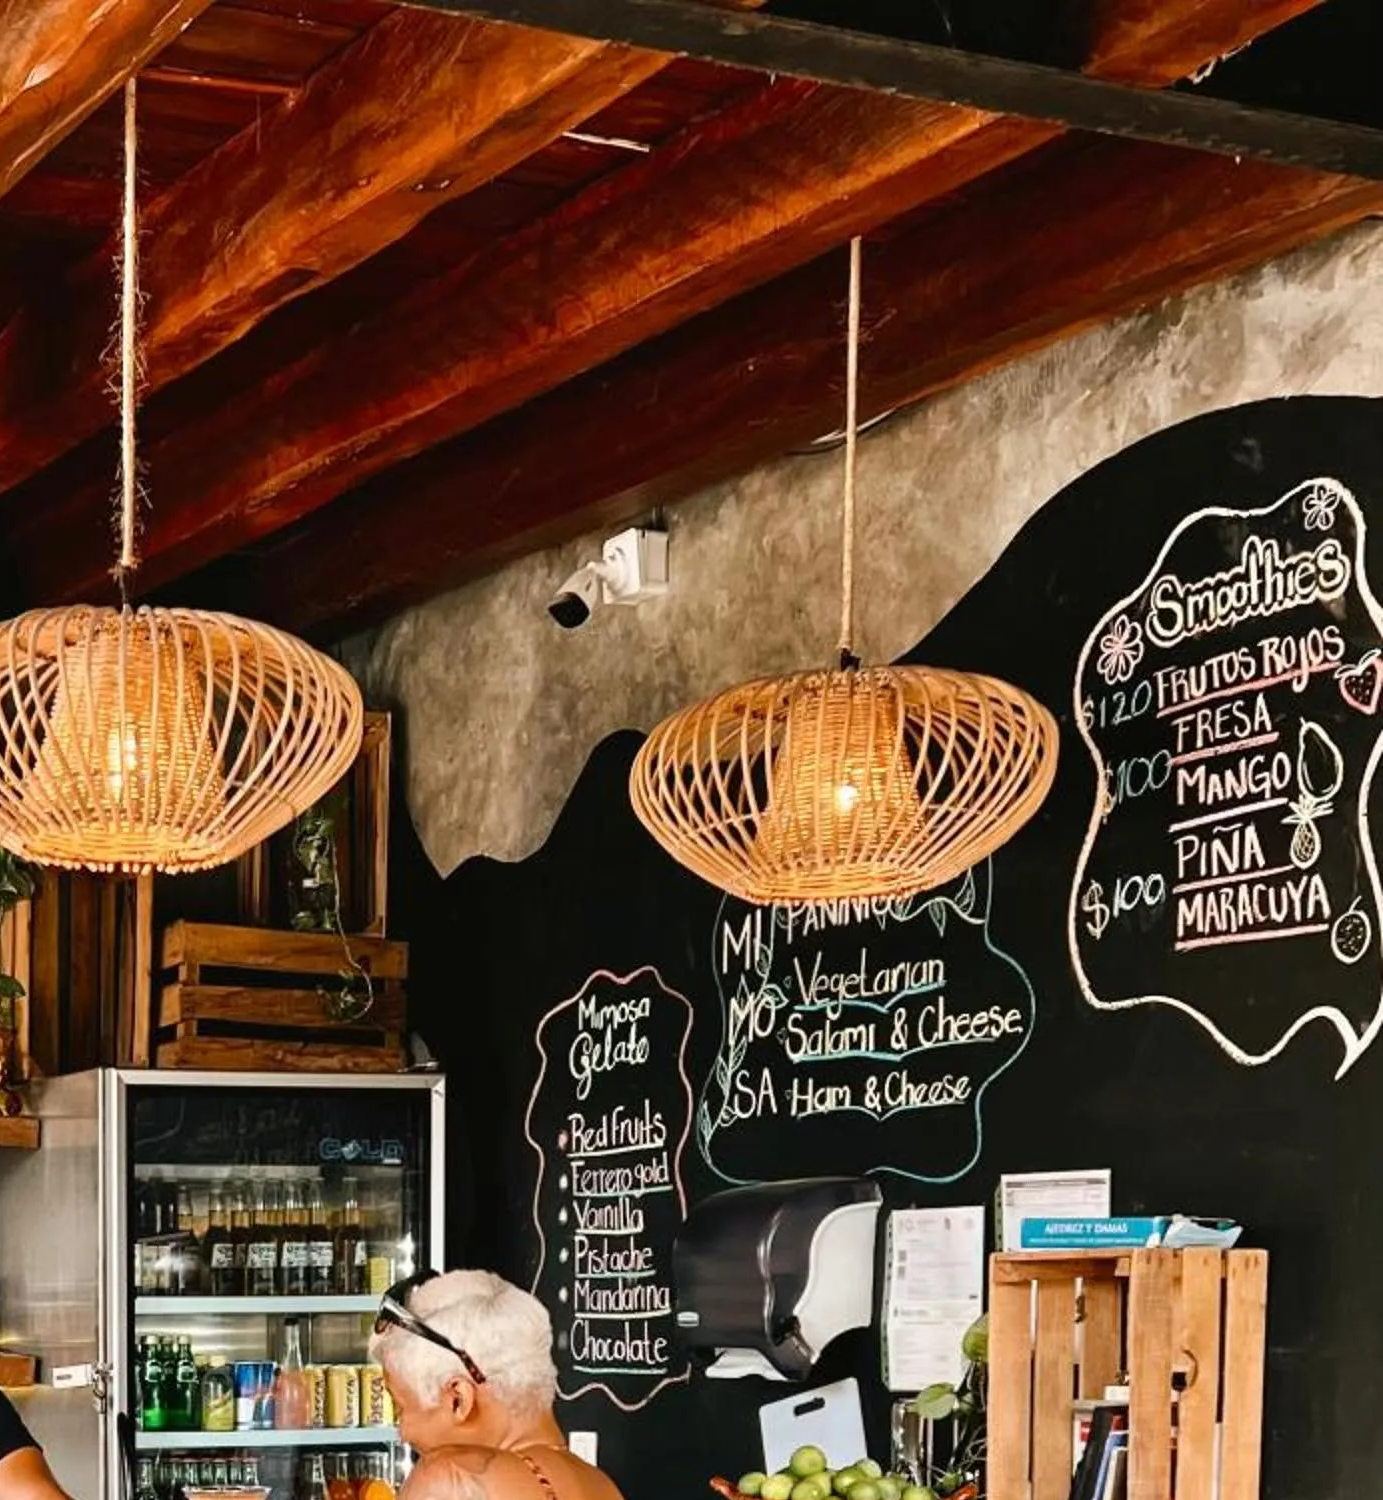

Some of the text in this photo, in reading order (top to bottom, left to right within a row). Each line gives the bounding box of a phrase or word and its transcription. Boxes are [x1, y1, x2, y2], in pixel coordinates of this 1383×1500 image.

[1146, 536, 1350, 648] Smoothies
[1082, 626, 1345, 731] $120 FRUTOS ROJOS
[1170, 693, 1272, 752] FRESA
[1177, 752, 1292, 806] MANGO
[1174, 822, 1266, 879] PIÑA
[1082, 873, 1331, 940] $100 MARACUYA
[578, 994, 650, 1031] Mimosa
[794, 948, 946, 1020] Vegetarian
[785, 1013, 876, 1062] Salami
[890, 1007, 909, 1050] &
[918, 996, 1024, 1048] Cheese
[569, 1022, 650, 1101] Gelato
[732, 1068, 972, 1119] SA Ham & Cheese
[571, 1160, 633, 1197] Ferrero
[574, 1235, 653, 1275] Pistache
[574, 1277, 670, 1312] Mandarina
[571, 1319, 670, 1365] Chocolate
